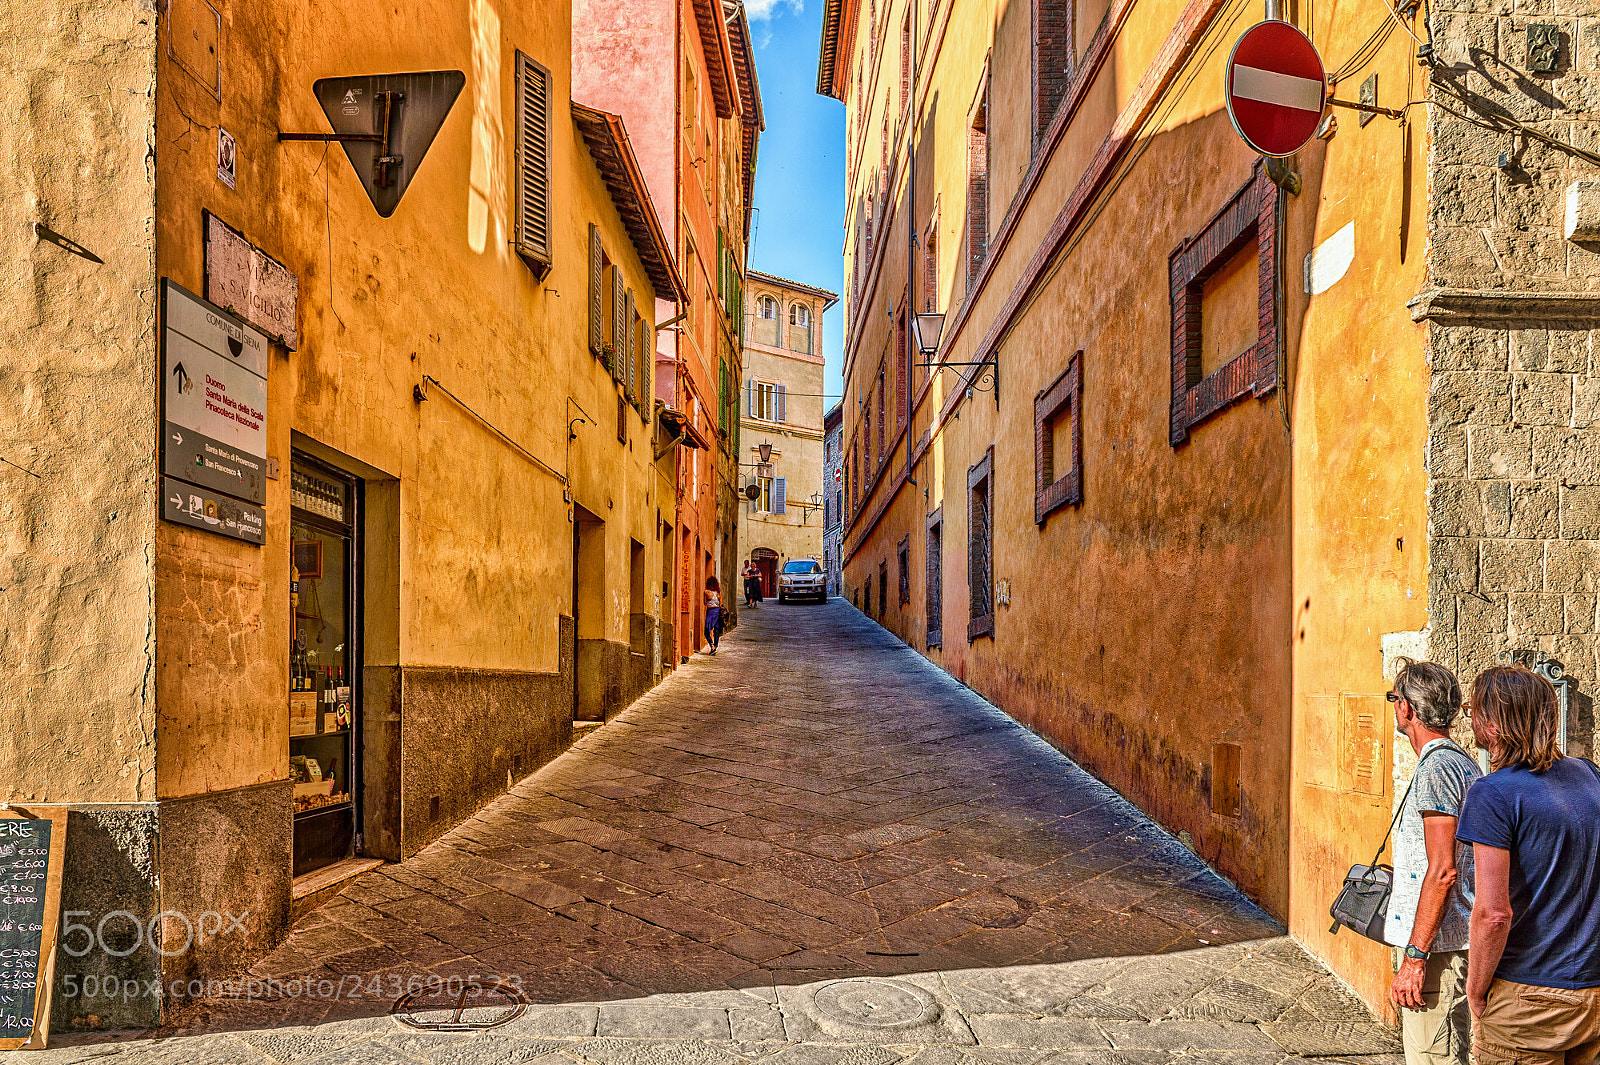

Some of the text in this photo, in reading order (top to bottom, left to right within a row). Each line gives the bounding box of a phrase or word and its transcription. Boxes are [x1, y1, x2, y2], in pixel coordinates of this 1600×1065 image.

[247, 260, 266, 286] VIA
[241, 285, 281, 322] VIGILIO
[205, 312, 233, 336] COMUNE
[243, 334, 261, 352] SIENA
[205, 374, 226, 391] Duomo
[205, 387, 264, 422] Santa Maria della Scala
[205, 400, 260, 431] Pinacoteca Nazionale
[205, 443, 218, 455] Santa
[218, 449, 231, 460] Maria
[205, 458, 236, 476] San Francesco
[225, 518, 236, 528] San
[243, 511, 262, 526] Parking
